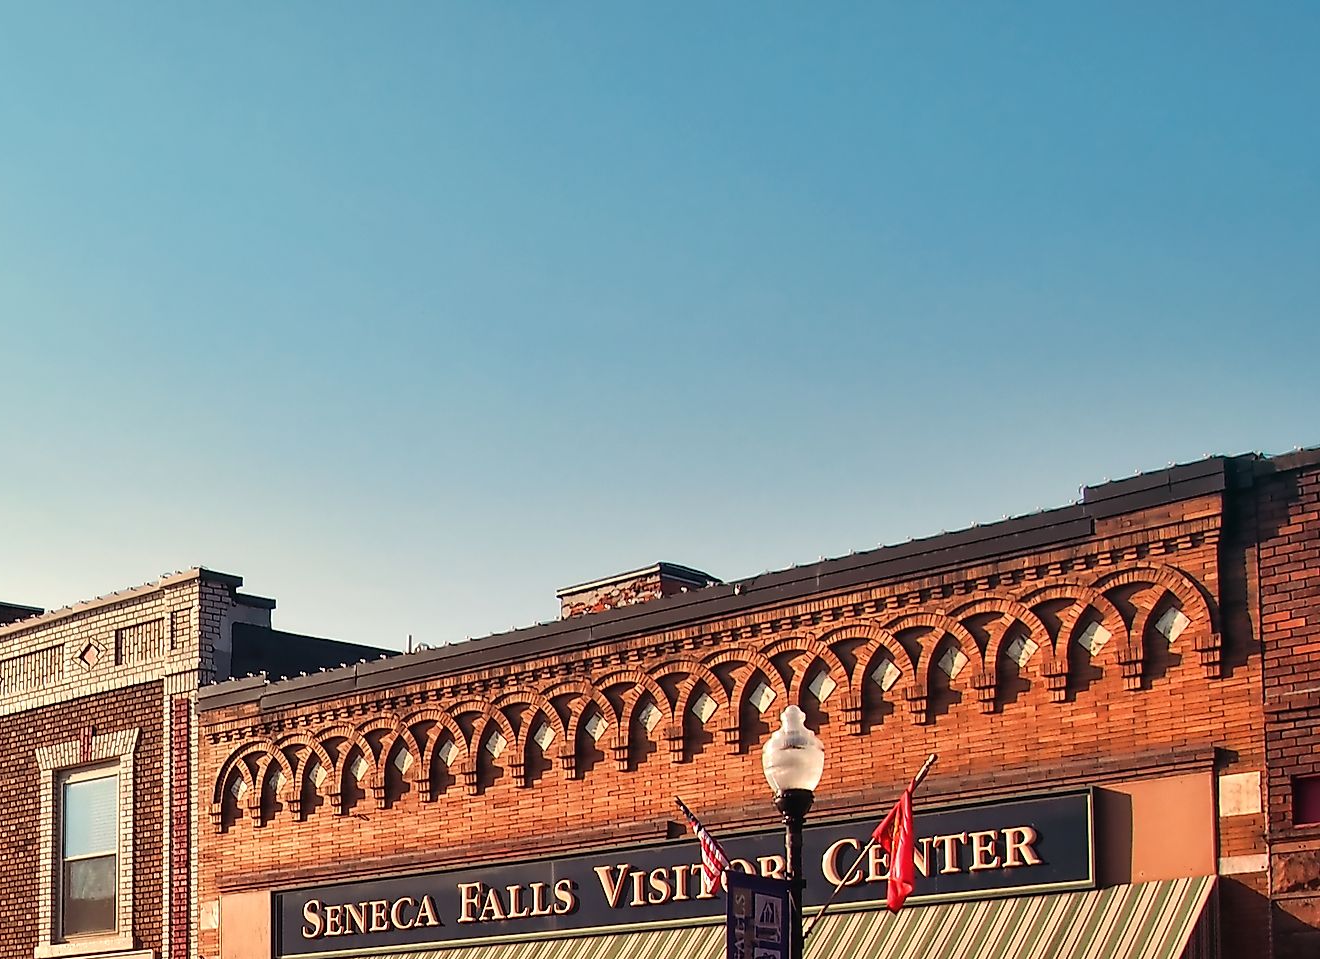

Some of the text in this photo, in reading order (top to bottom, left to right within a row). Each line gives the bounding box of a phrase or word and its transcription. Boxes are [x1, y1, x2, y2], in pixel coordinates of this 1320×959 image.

[302, 894, 441, 939] SENECA
[457, 879, 577, 923] FALLS
[821, 826, 1044, 887] CENTER
